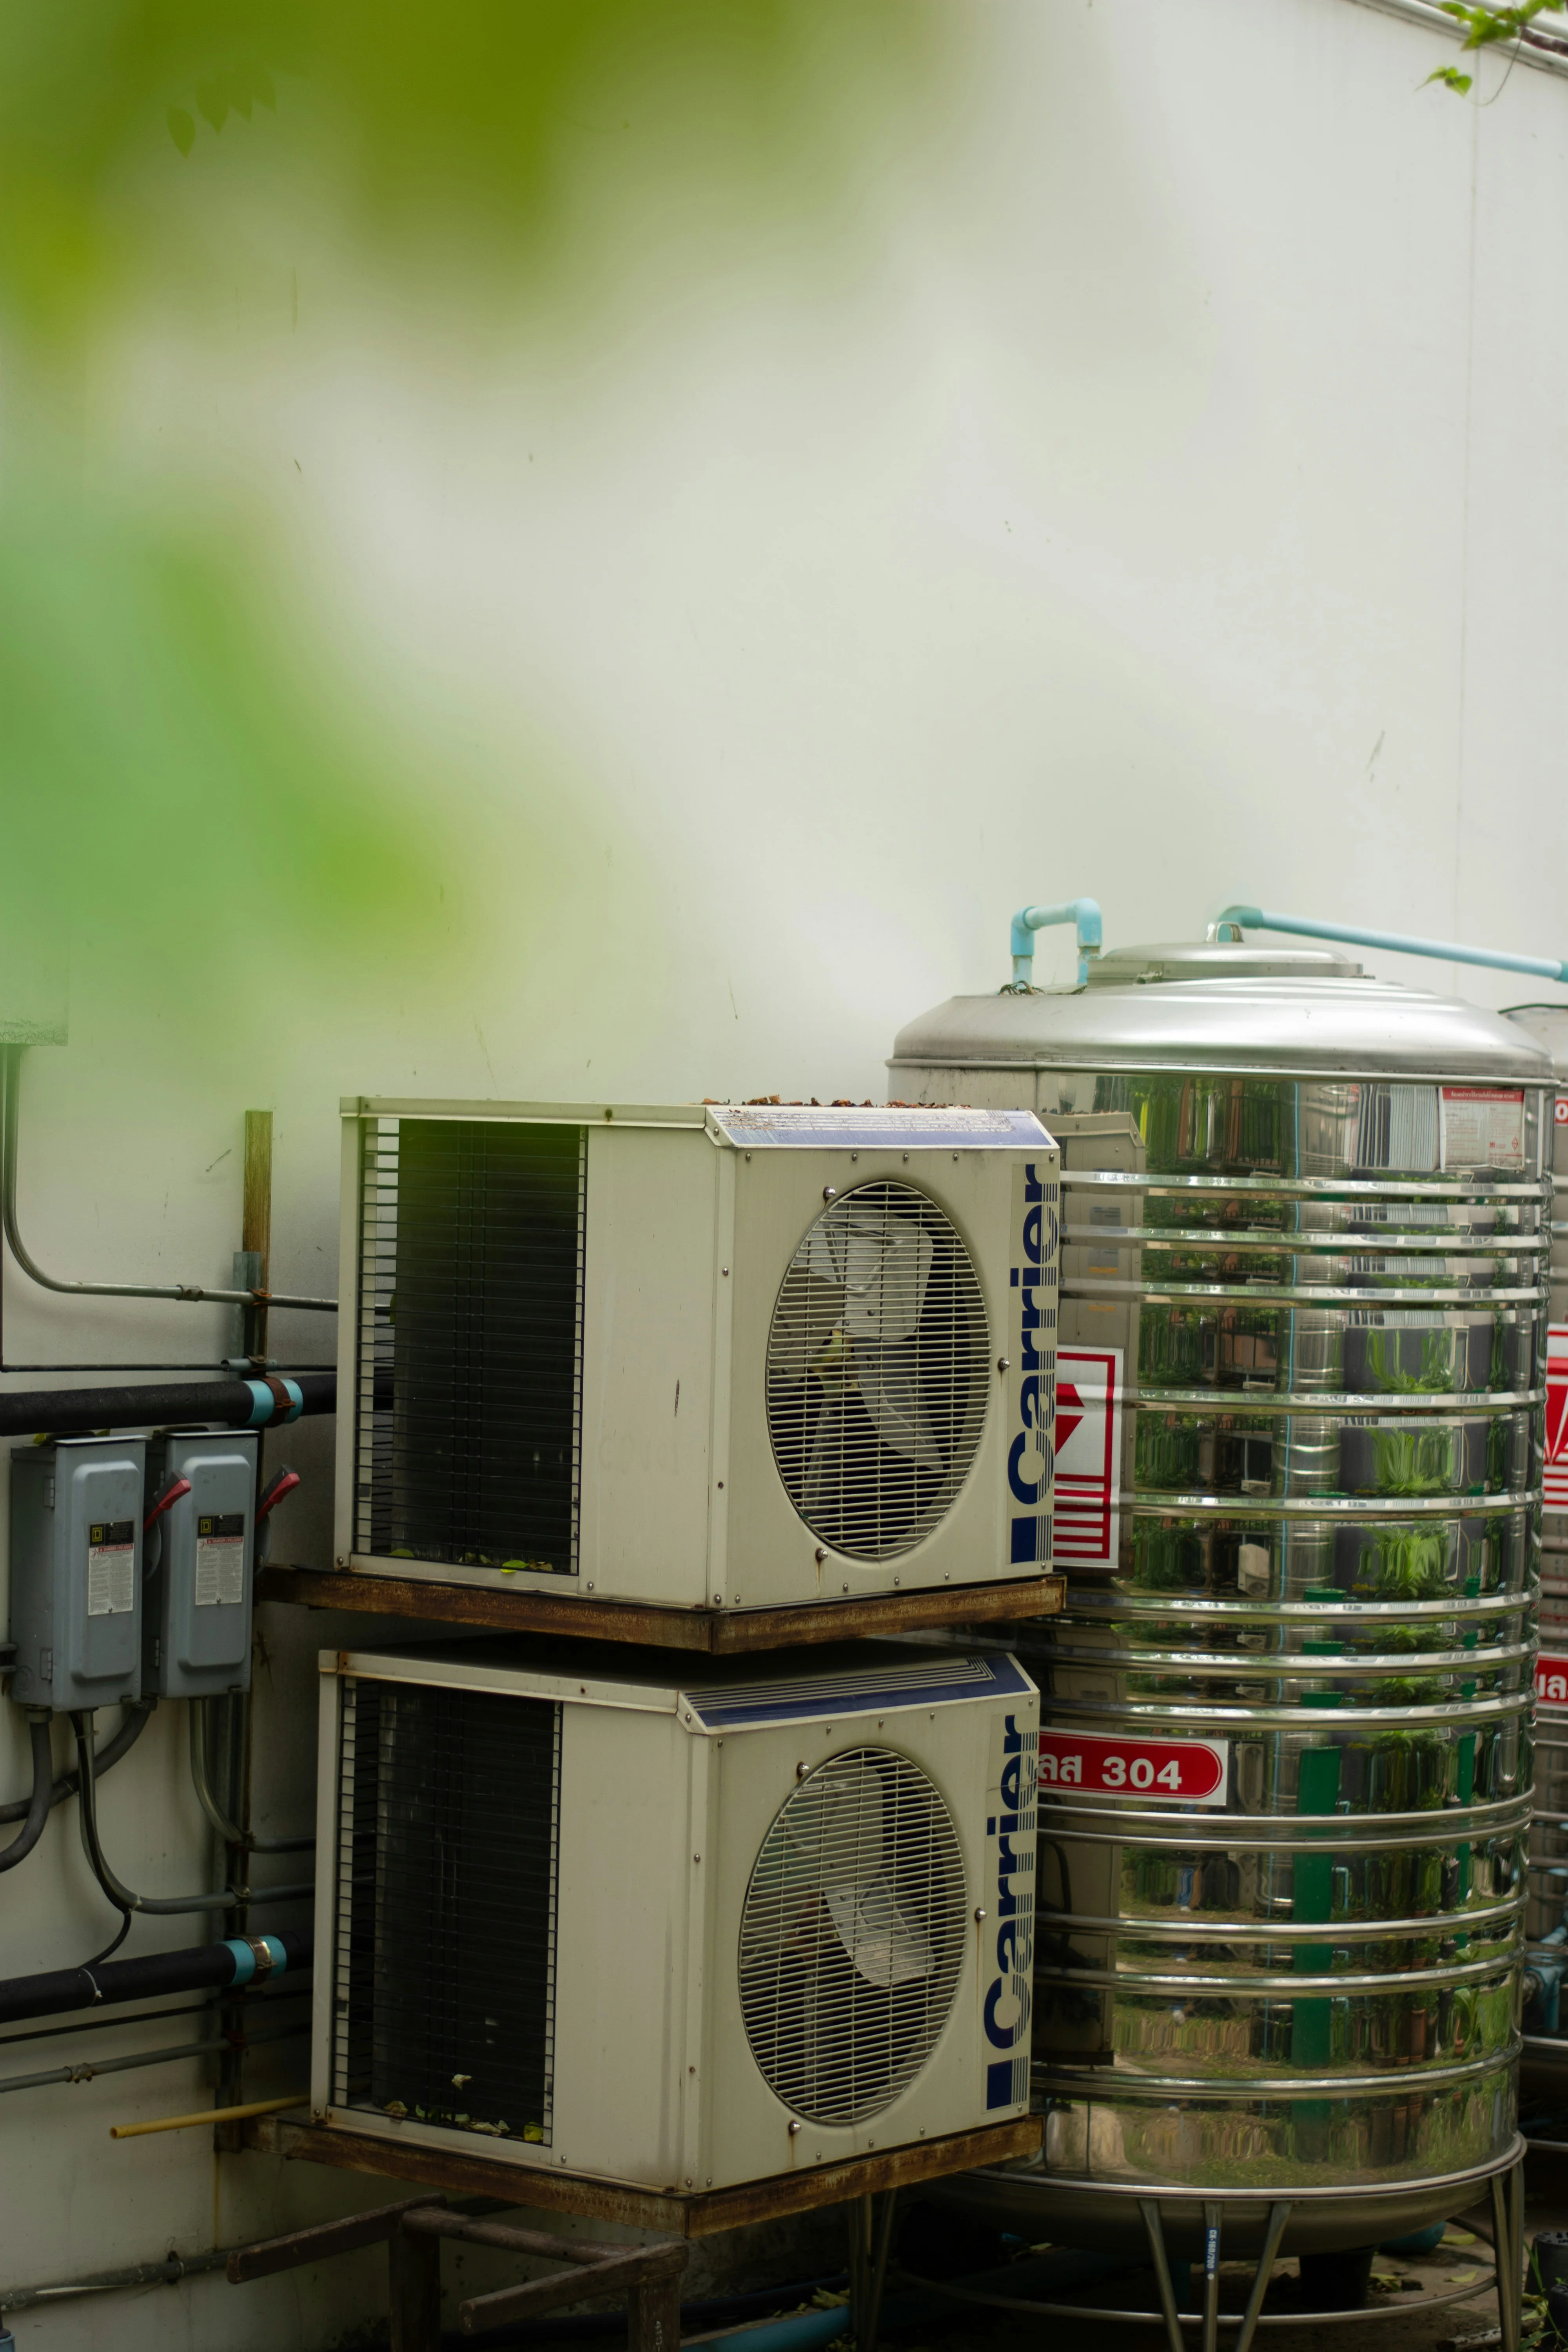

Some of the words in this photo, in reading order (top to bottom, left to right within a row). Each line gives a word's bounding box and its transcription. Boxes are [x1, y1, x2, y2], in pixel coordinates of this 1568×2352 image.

[1008, 1163, 1058, 1505] Carrier
[984, 1714, 1038, 2049] Carrier
[1101, 1756, 1182, 1790] 304
